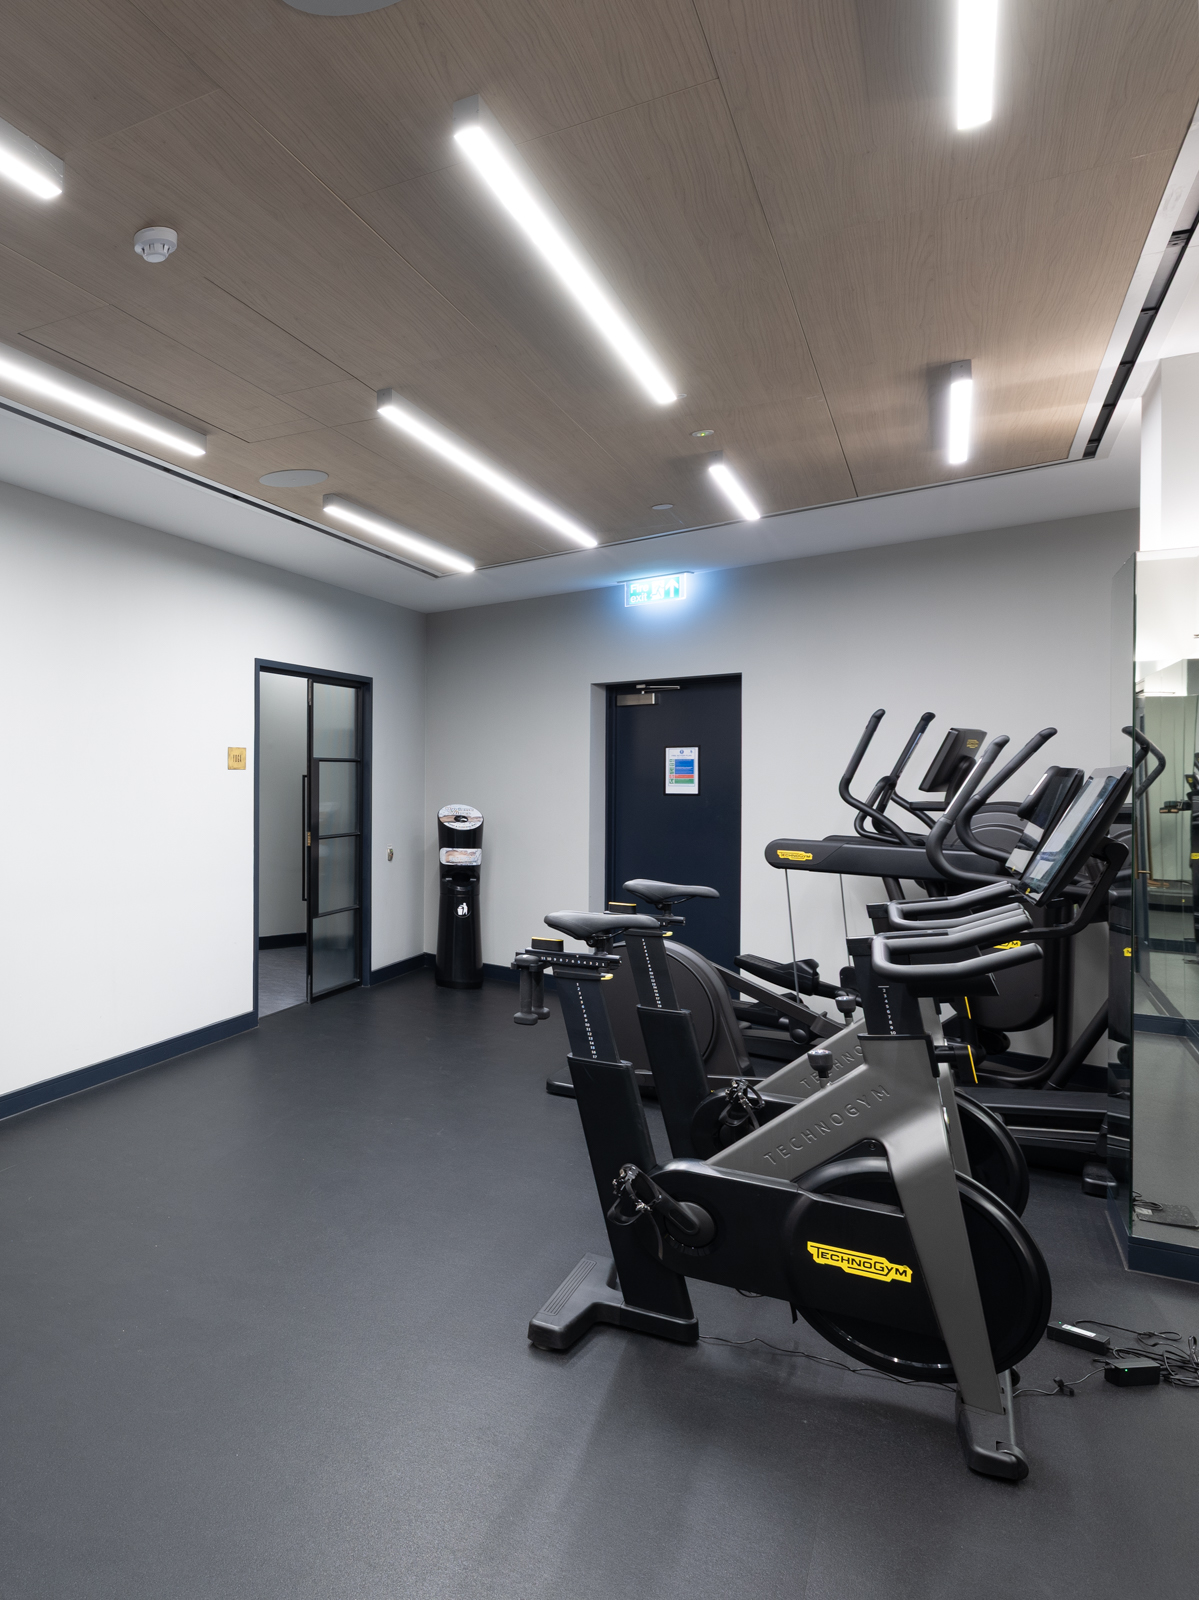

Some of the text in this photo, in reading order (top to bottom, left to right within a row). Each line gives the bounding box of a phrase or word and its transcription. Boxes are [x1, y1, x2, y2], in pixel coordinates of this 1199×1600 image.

[631, 584, 649, 593] Fire
[631, 593, 647, 603] exit
[800, 1044, 863, 1089] TEHNO
[763, 1084, 890, 1165] TECHNOGYM
[810, 1244, 908, 1278] TECHNOGYM
